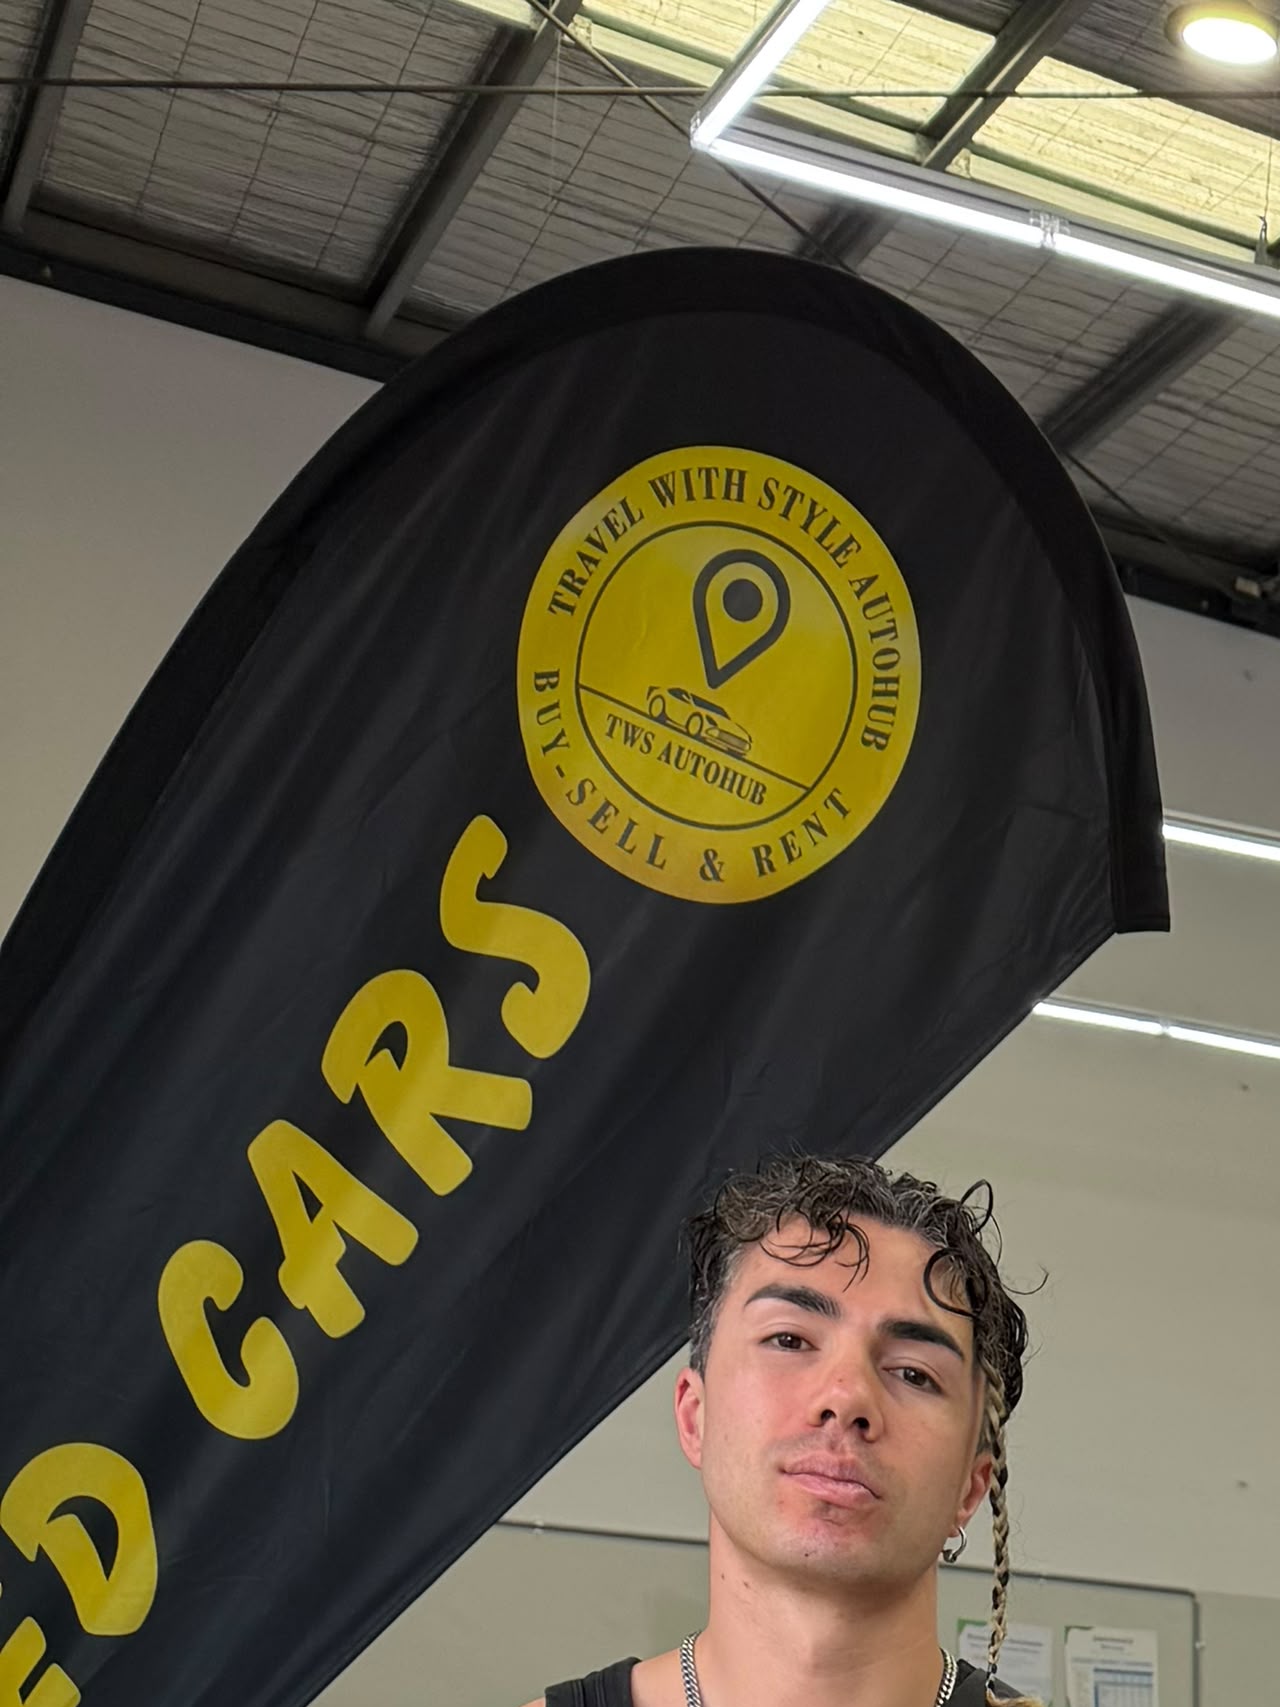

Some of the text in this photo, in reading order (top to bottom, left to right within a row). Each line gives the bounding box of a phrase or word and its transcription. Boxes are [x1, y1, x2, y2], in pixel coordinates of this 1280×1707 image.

[548, 466, 902, 752] TRAVEL WITH STYLE AUTOHUB
[604, 713, 768, 806] TWS AUTOHUB
[699, 847, 725, 882] &
[751, 787, 852, 877] RENT
[158, 814, 592, 1440] CARS
